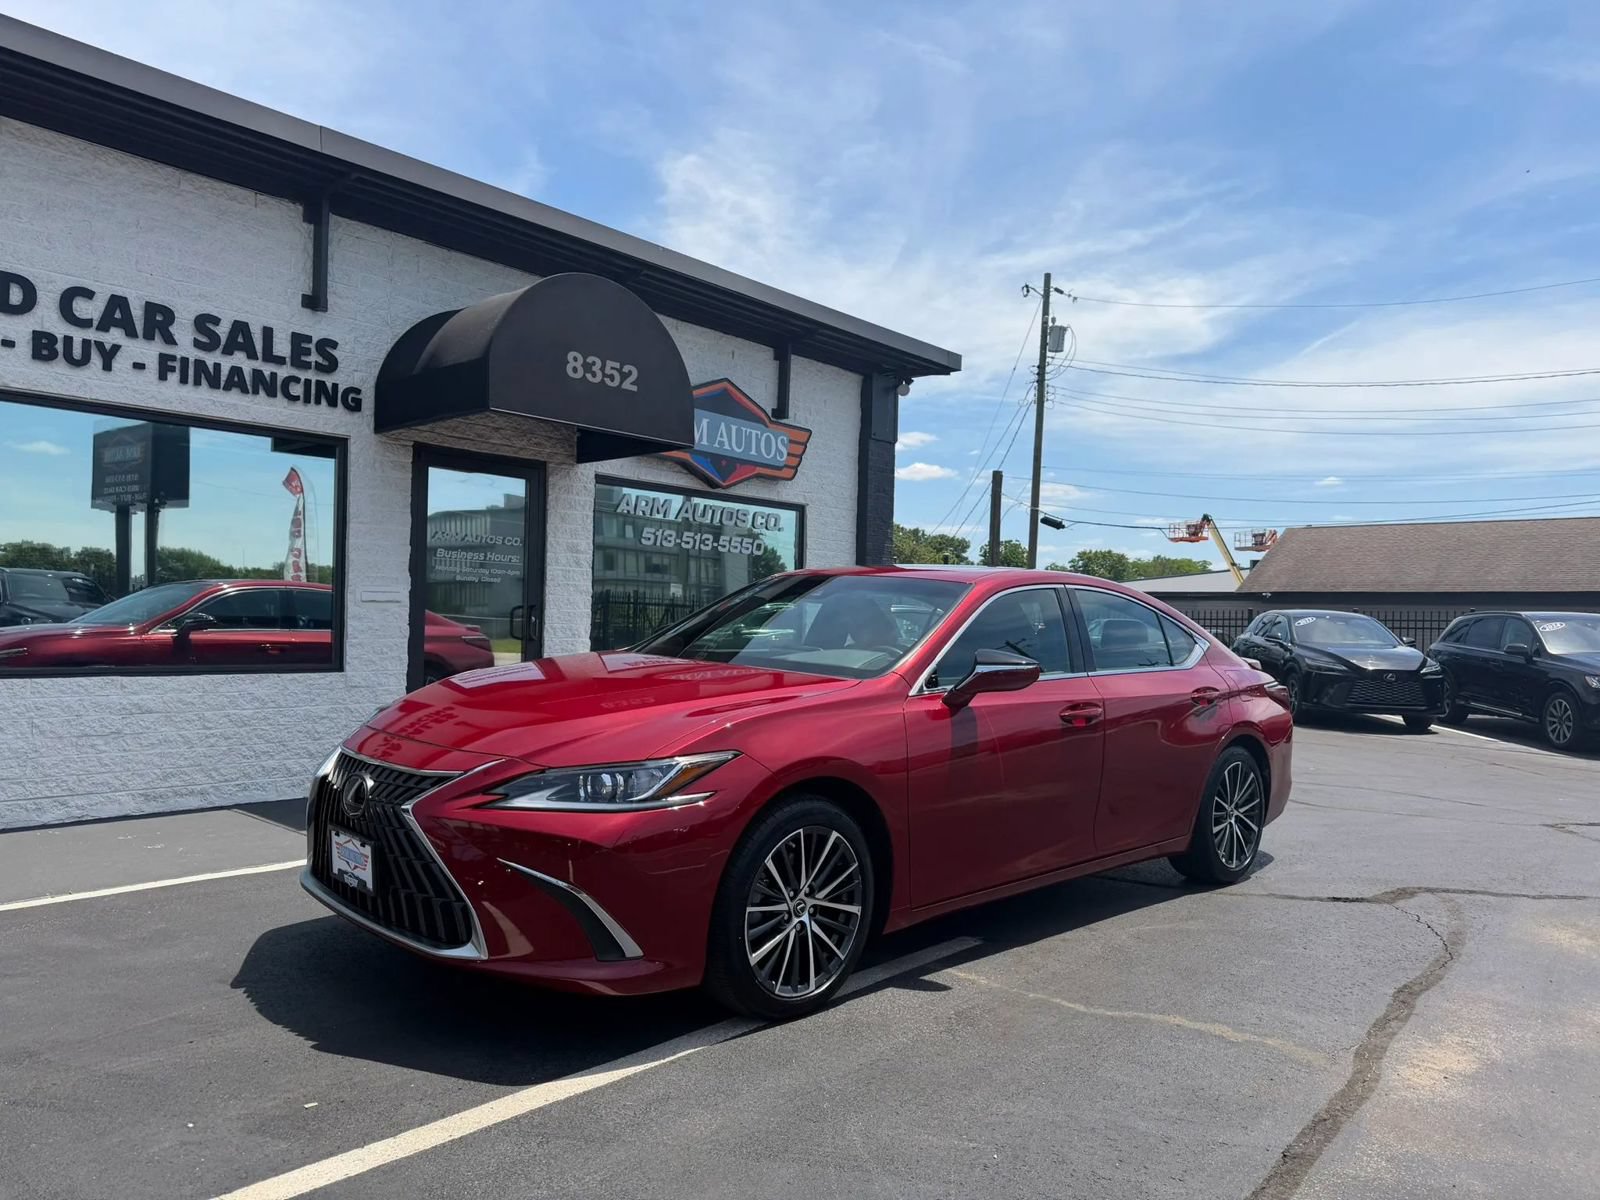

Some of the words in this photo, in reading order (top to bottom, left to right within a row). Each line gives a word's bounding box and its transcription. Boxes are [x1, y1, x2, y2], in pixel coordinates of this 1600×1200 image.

[59, 286, 178, 345] CAR
[193, 313, 339, 374] SALES
[31, 330, 122, 372] BUY
[158, 352, 362, 412] FINANCING
[566, 351, 639, 392] 8352
[713, 422, 788, 461] AUTOS
[616, 493, 673, 519] ARM
[674, 500, 750, 529] AUTOS
[751, 511, 784, 532] CO.
[436, 548, 485, 561] Business
[486, 551, 521, 563] Hours:
[640, 527, 765, 556] 513-513-5550
